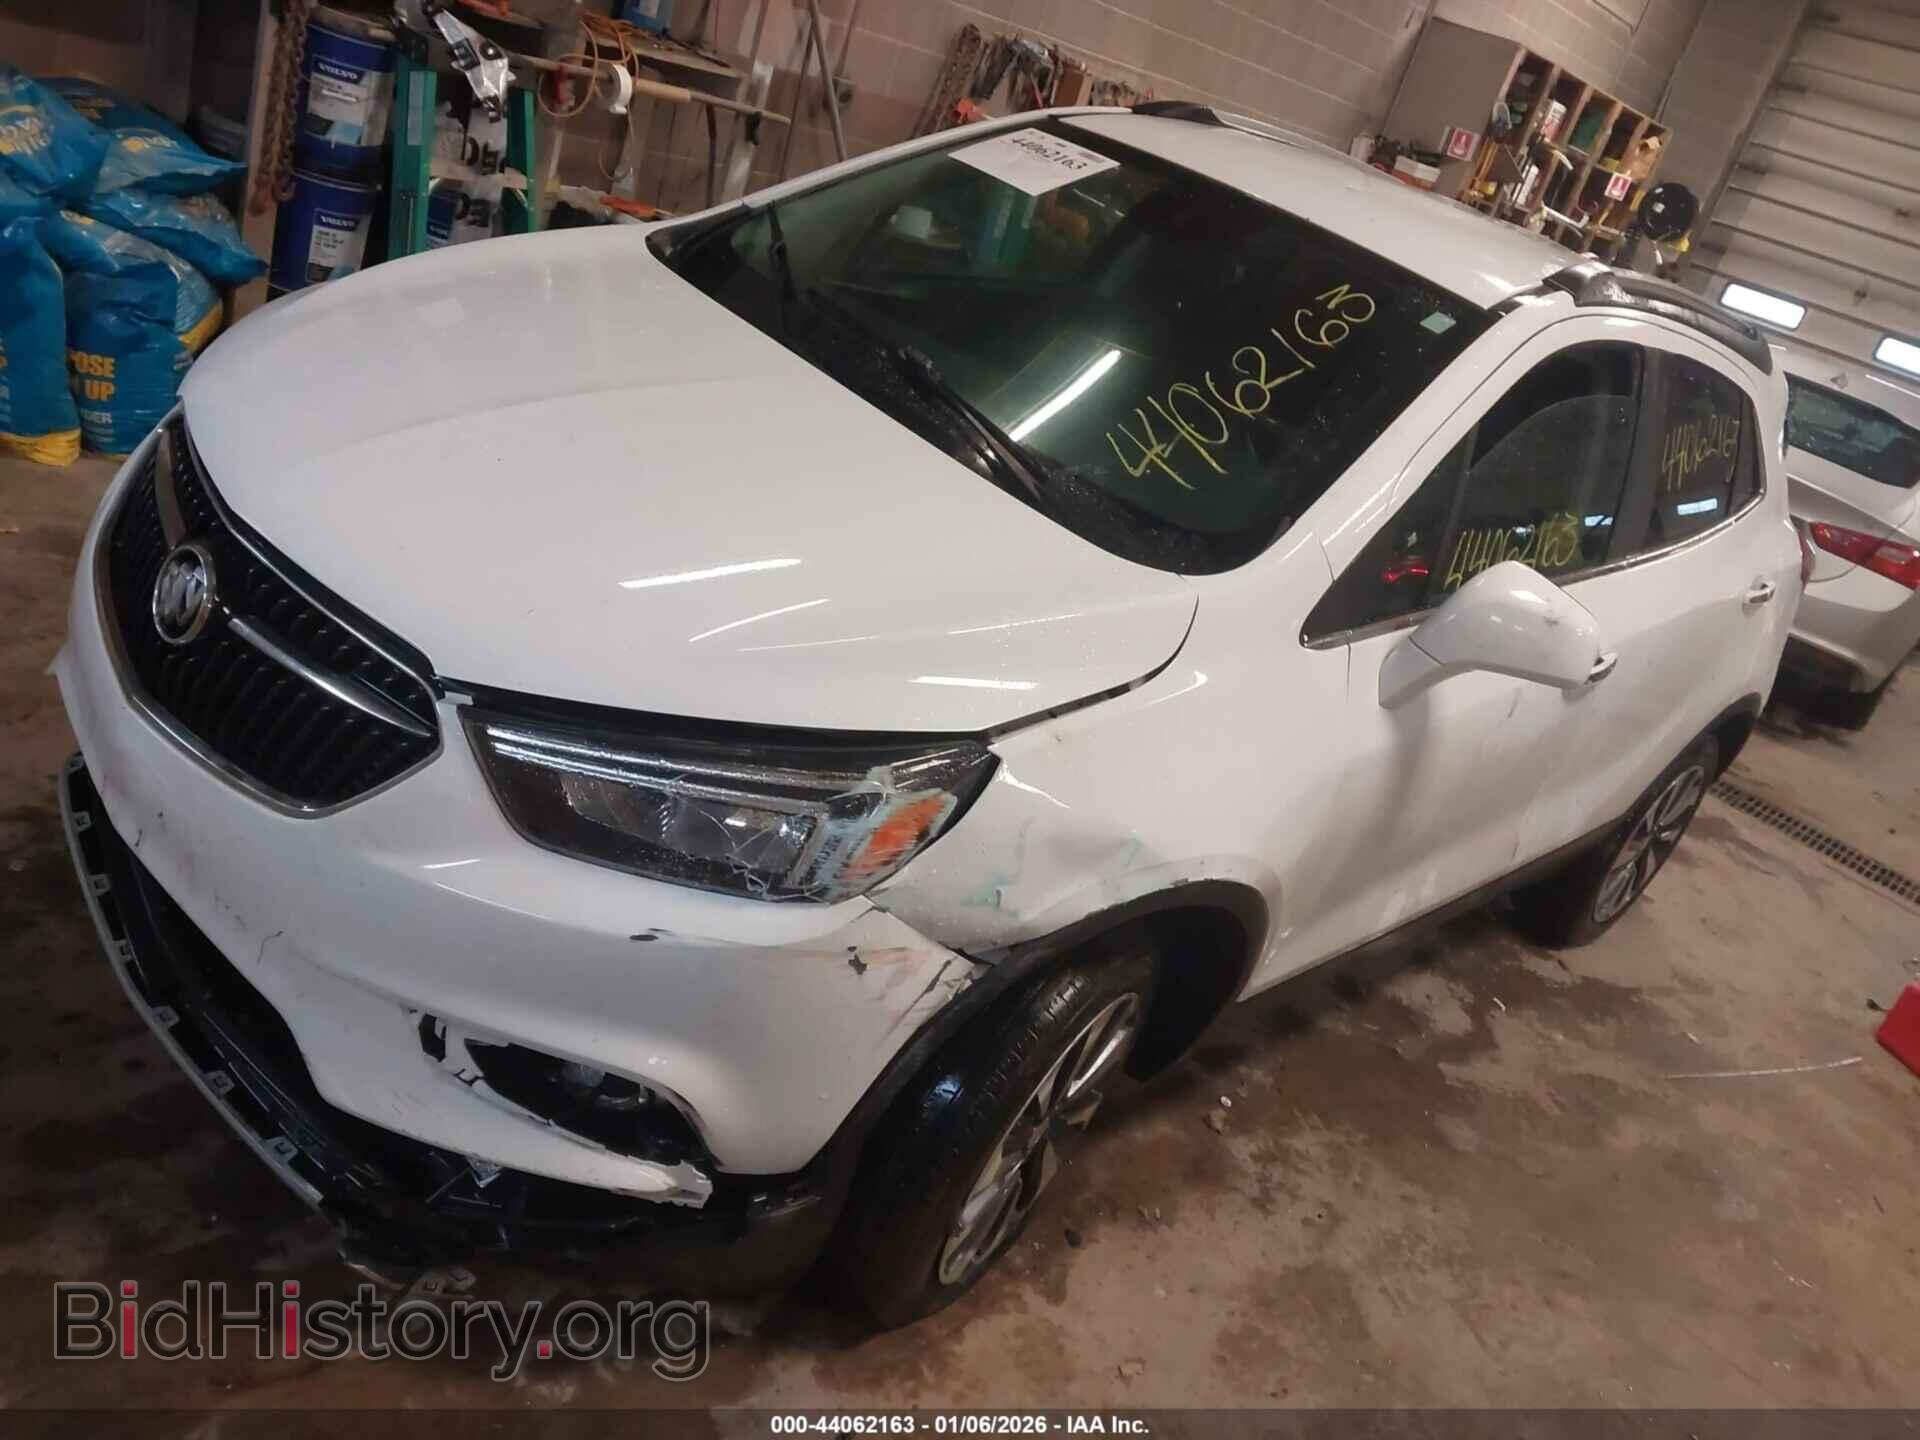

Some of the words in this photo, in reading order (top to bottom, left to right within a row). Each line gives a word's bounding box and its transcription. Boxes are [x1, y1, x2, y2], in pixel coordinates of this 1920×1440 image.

[317, 61, 359, 80] VOLVO
[84, 379, 116, 401] UP
[1105, 282, 1376, 491] 44062163
